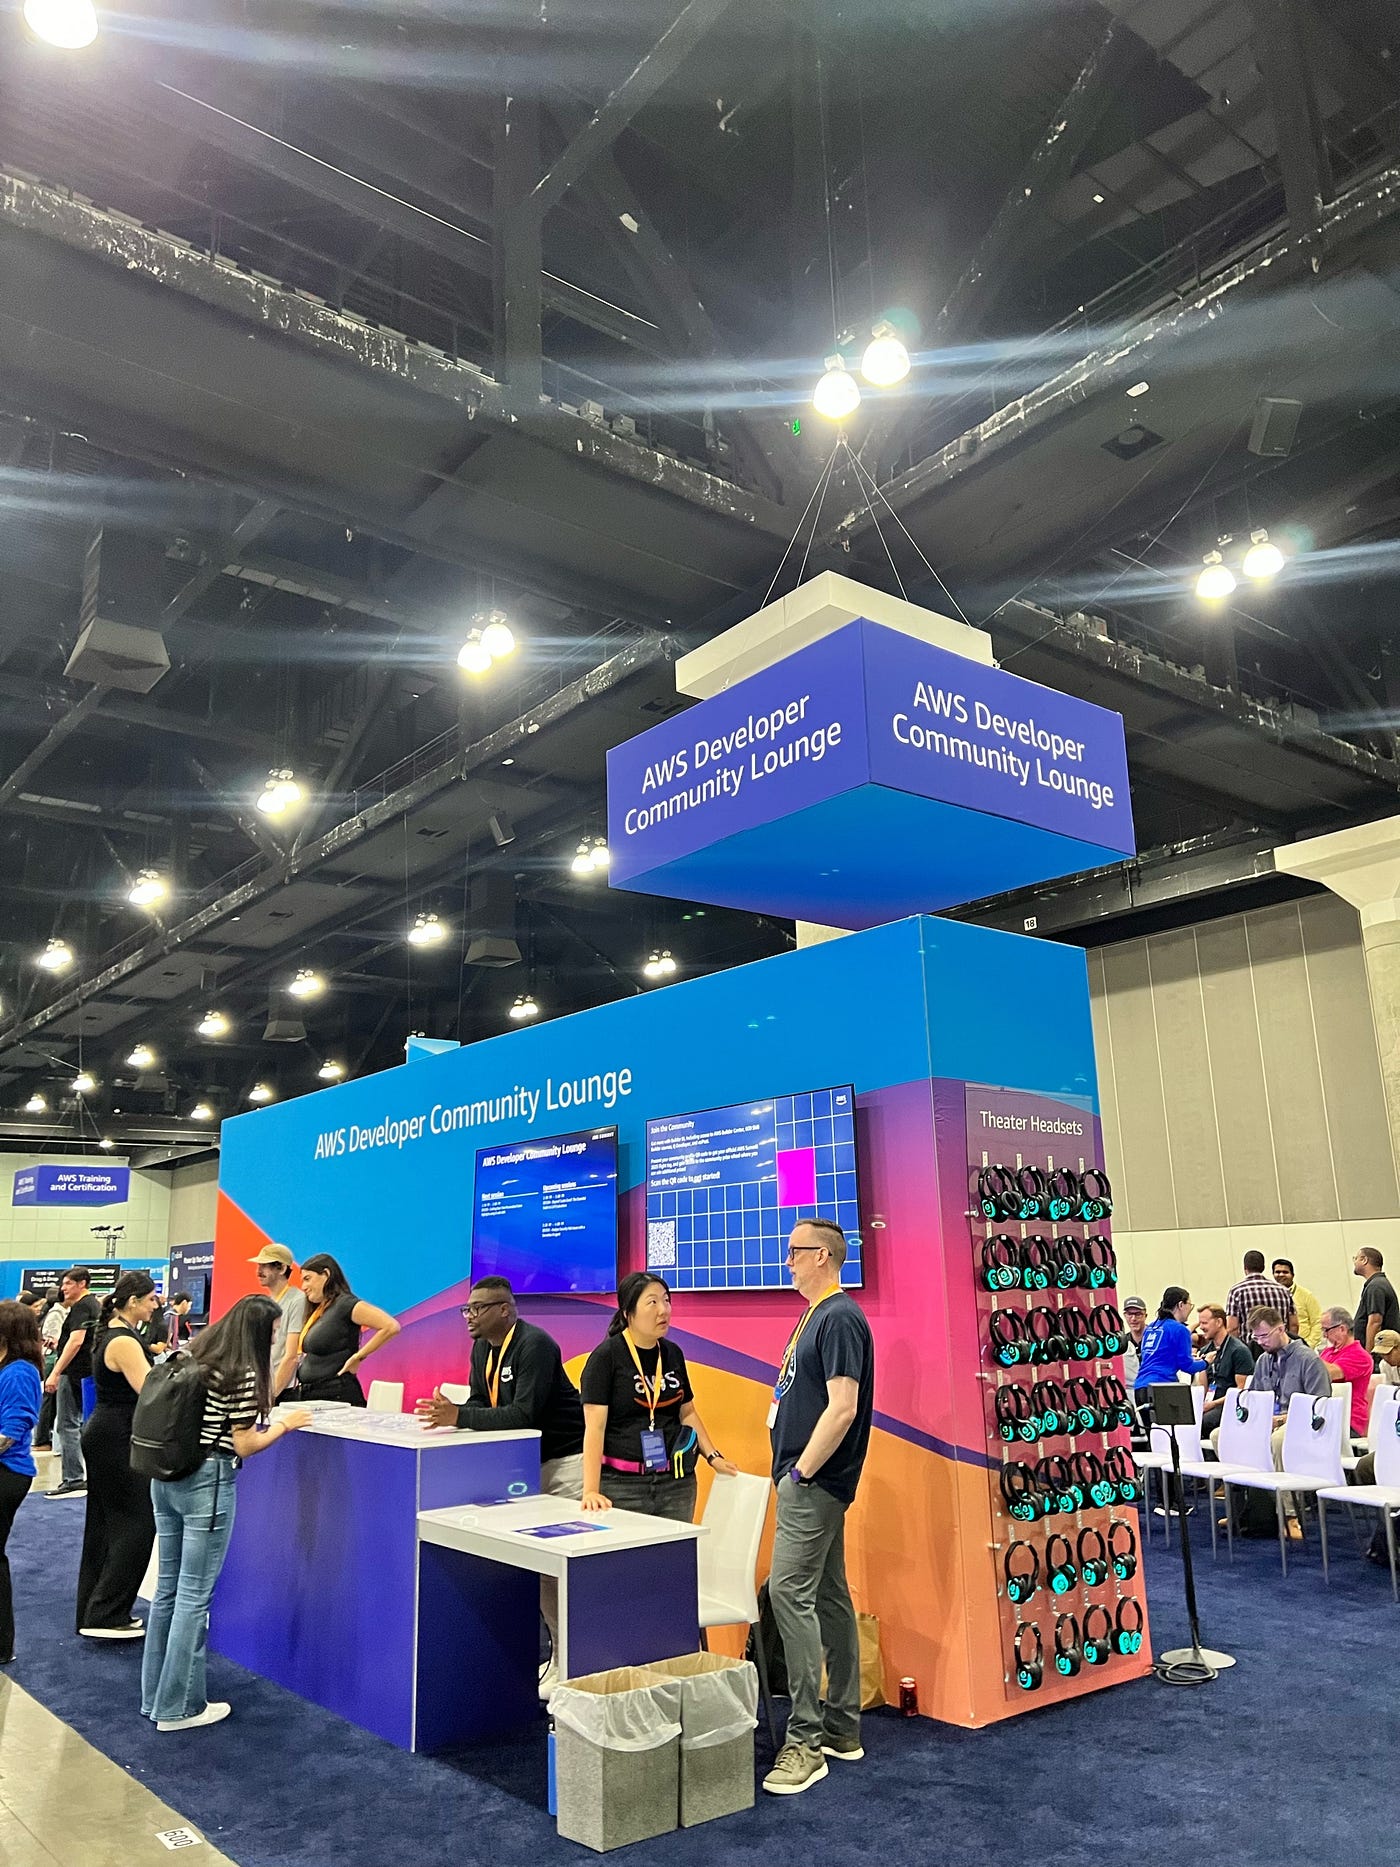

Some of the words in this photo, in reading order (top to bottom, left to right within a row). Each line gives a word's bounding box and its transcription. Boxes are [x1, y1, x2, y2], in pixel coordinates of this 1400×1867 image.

[913, 681, 969, 724] AWS
[974, 701, 1086, 763] Developer
[641, 749, 688, 795] AWS
[694, 695, 810, 769] Developer
[892, 713, 1031, 787] Community
[1036, 758, 1114, 808] Lounge
[624, 765, 745, 835] Community
[751, 721, 841, 781] Lounge
[1026, 919, 1035, 928] 18
[314, 1126, 346, 1160] AWS
[348, 1115, 427, 1153] Developer
[430, 1085, 540, 1135] Community
[546, 1068, 632, 1110] Lounge
[668, 1121, 695, 1131] Community
[979, 1110, 1028, 1131] Theater
[1030, 1115, 1083, 1136] Headsets
[482, 1156, 496, 1167] AWS
[496, 1152, 526, 1165] Developer
[525, 1145, 561, 1160] Community
[562, 1142, 587, 1154] Lounge
[50, 1183, 66, 1191] and
[67, 1183, 117, 1192] Certification
[57, 1174, 77, 1182] AWS
[78, 1173, 112, 1184] Training
[633, 1371, 680, 1394] aws
[164, 1830, 193, 1847] 600
